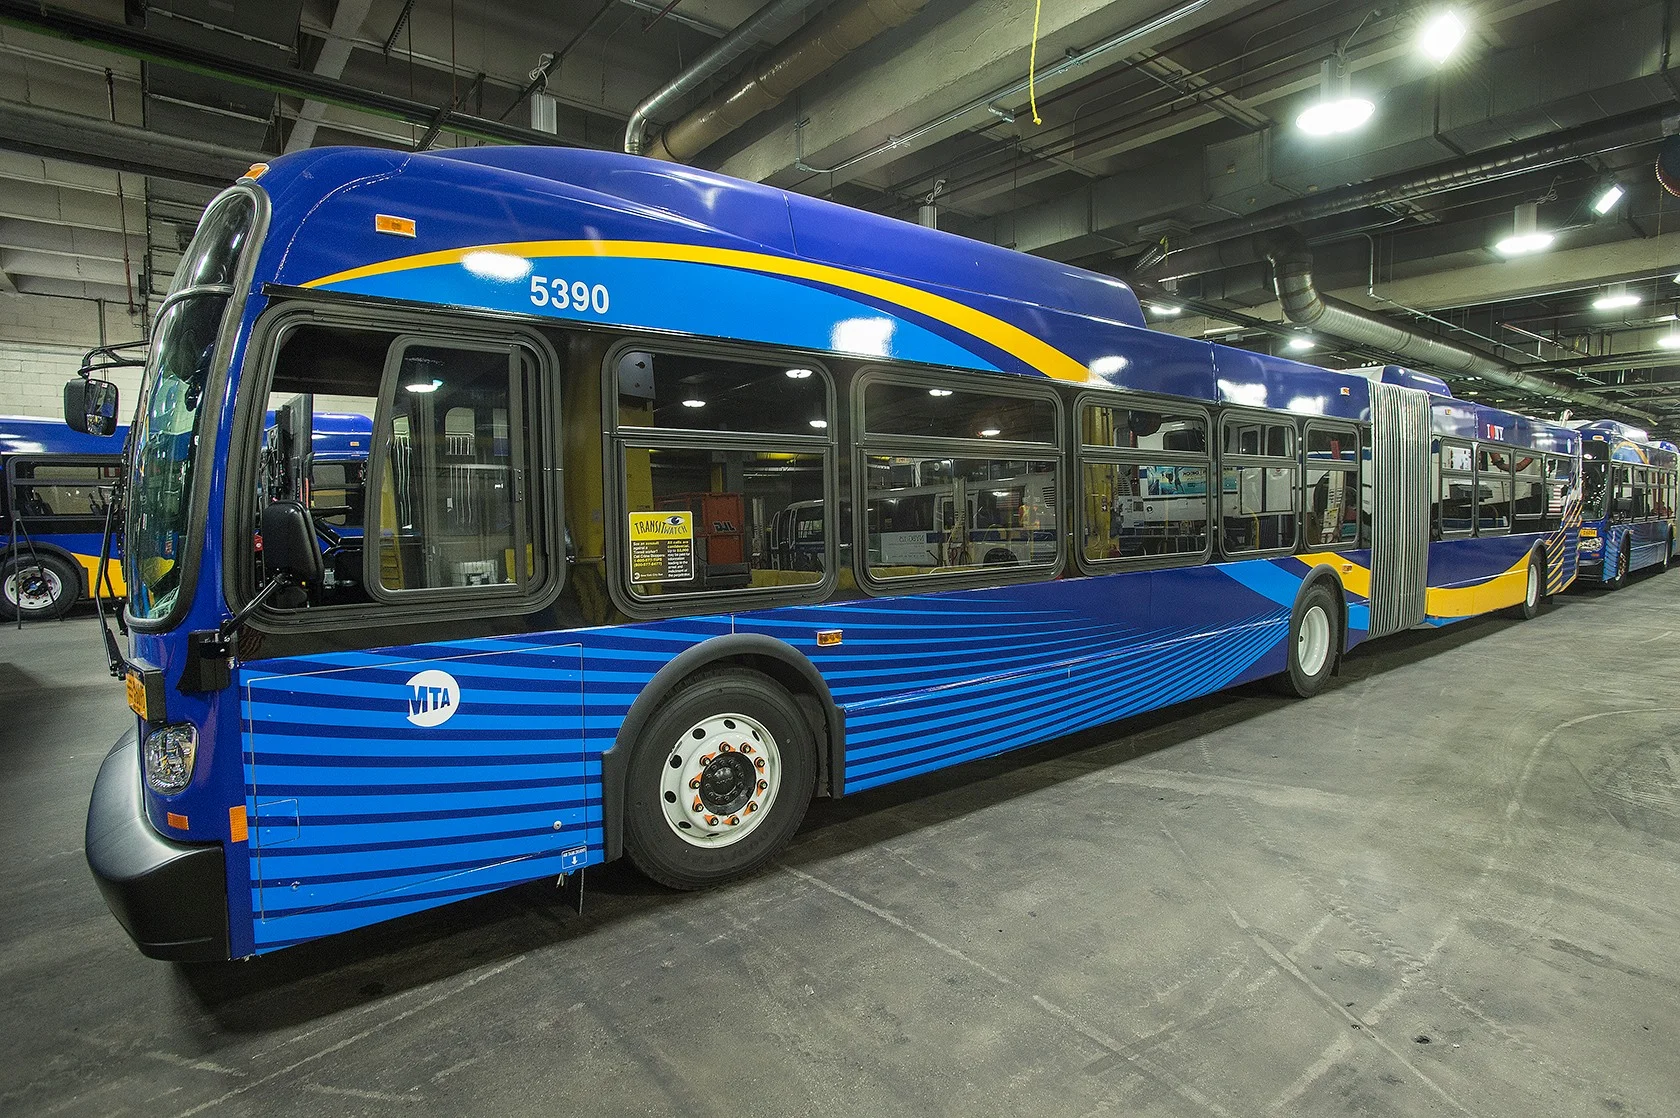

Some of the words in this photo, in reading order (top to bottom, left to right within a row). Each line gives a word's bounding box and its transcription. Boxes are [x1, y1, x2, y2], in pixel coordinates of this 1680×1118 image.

[530, 275, 610, 315] 5390
[1486, 423, 1491, 439] I
[1494, 425, 1504, 441] NY
[405, 684, 451, 717] MTA
